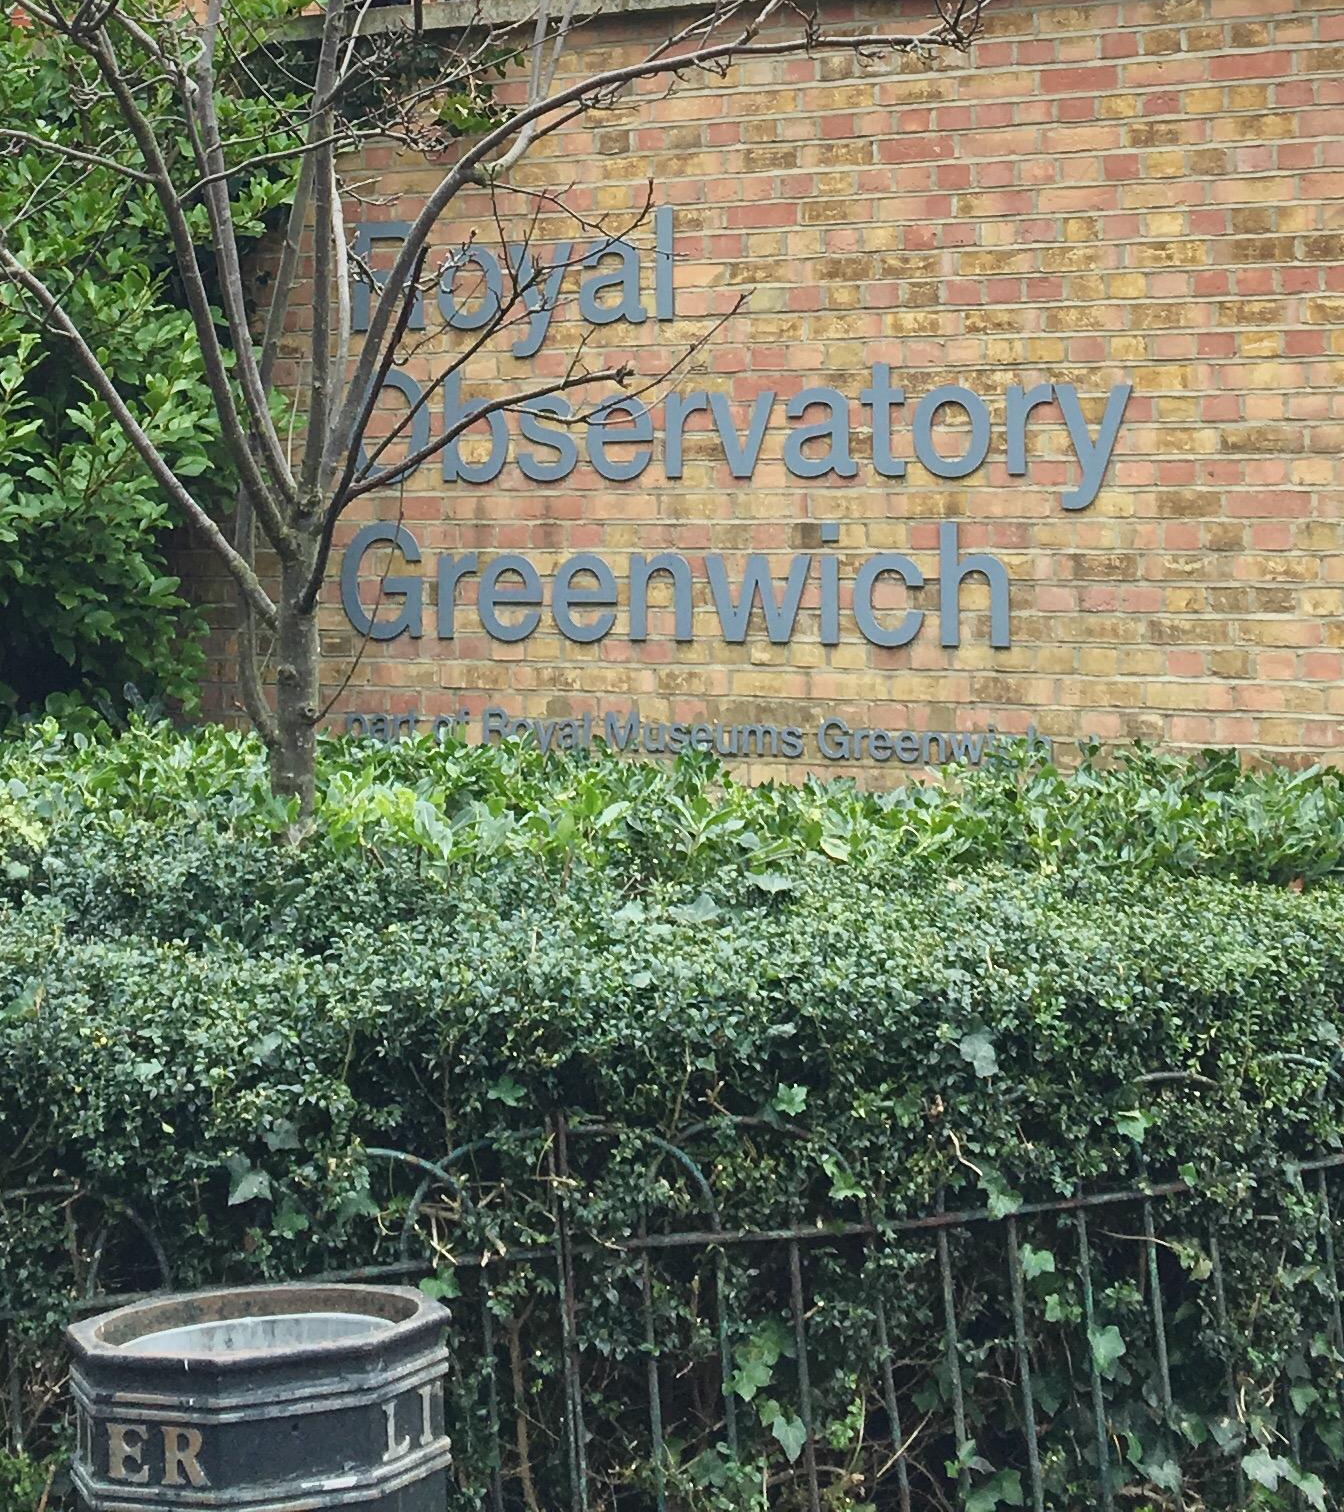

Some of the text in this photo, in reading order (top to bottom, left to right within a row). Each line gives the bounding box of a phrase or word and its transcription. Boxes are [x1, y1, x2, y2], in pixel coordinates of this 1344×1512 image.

[352, 205, 675, 359] Royal
[349, 363, 1131, 509] Observatory
[340, 521, 1011, 648] Greenwich
[482, 706, 591, 754] Royal
[605, 711, 804, 758] Museums
[105, 1381, 445, 1487] ER LI
